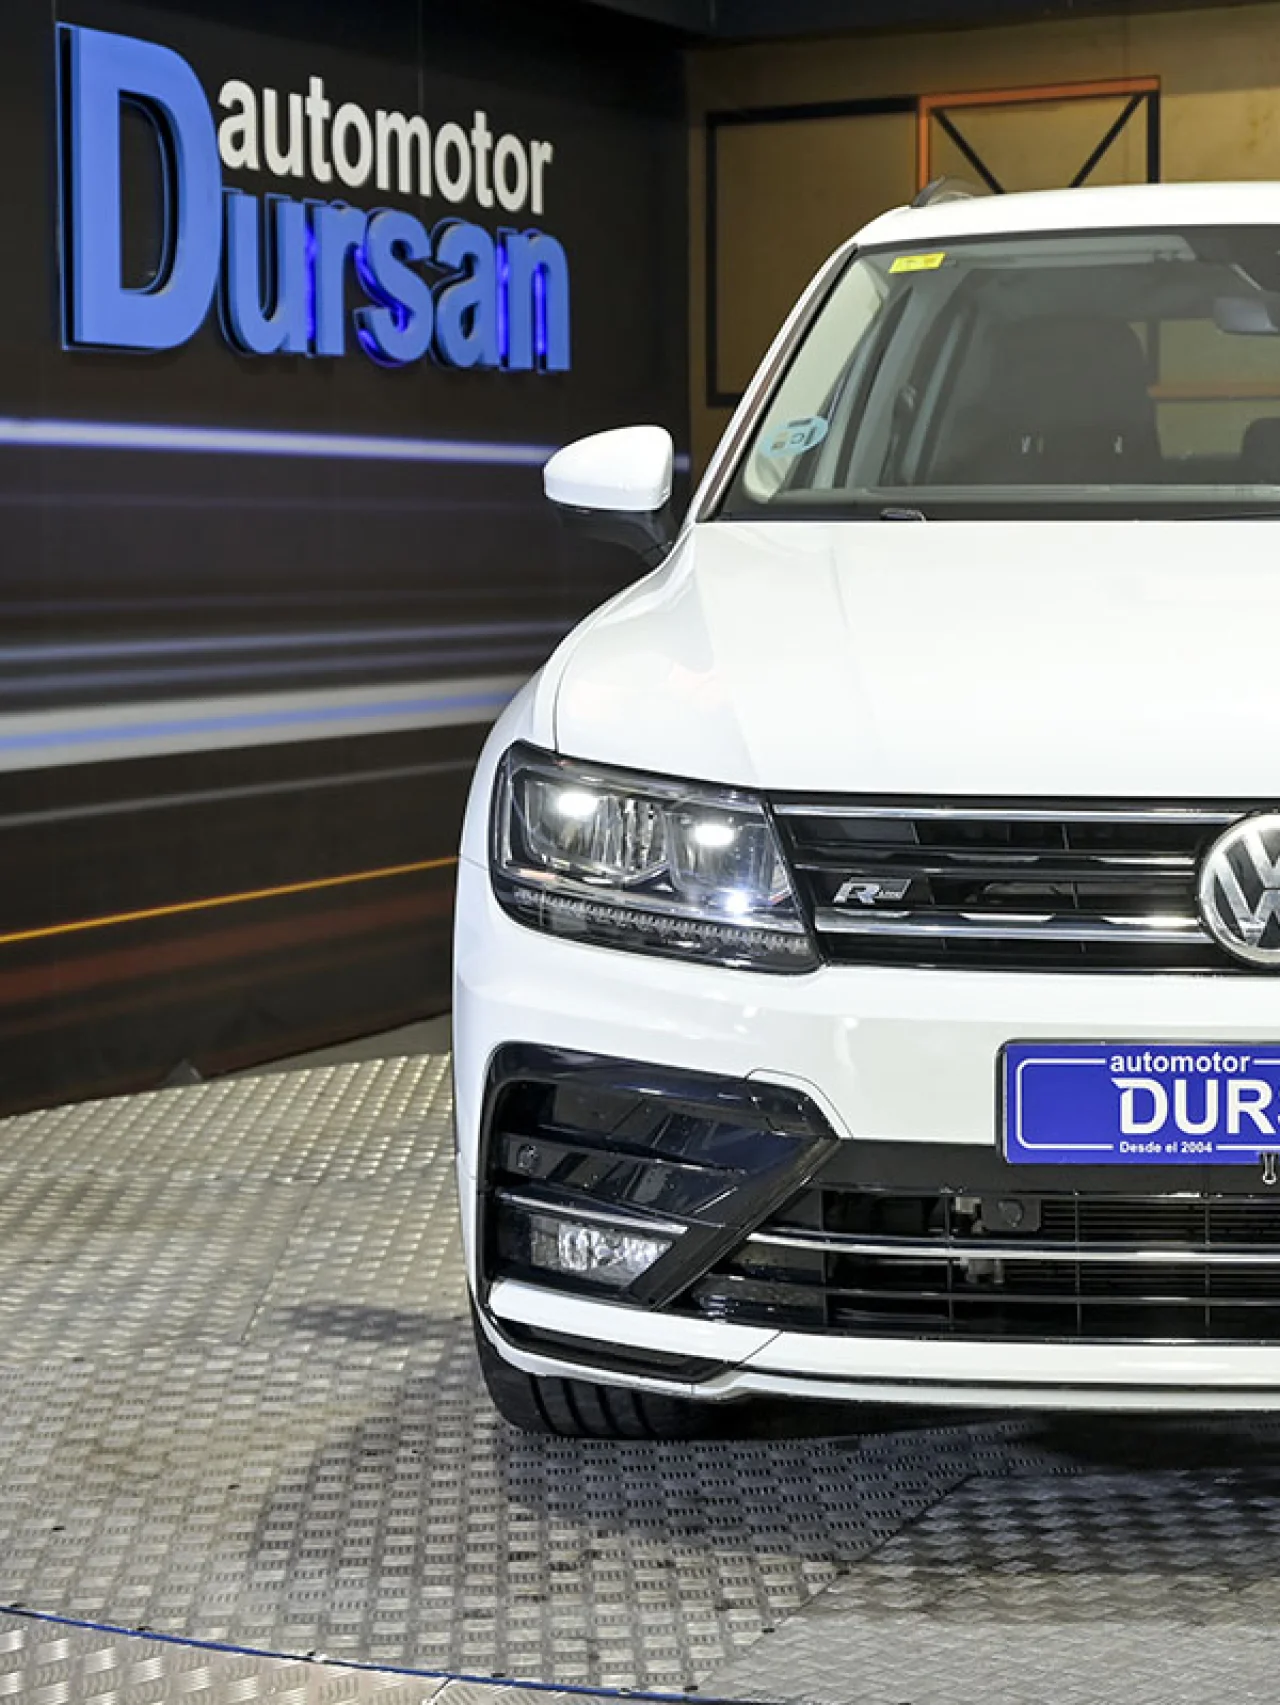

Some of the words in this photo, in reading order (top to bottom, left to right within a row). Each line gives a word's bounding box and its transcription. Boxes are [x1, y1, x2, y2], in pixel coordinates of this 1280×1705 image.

[218, 76, 553, 214] automotor
[56, 21, 570, 371] Dursan
[1110, 1051, 1250, 1073] automotor
[1119, 1141, 1162, 1153] Desde
[1165, 1141, 1178, 1153] el
[1181, 1141, 1213, 1153] 2004
